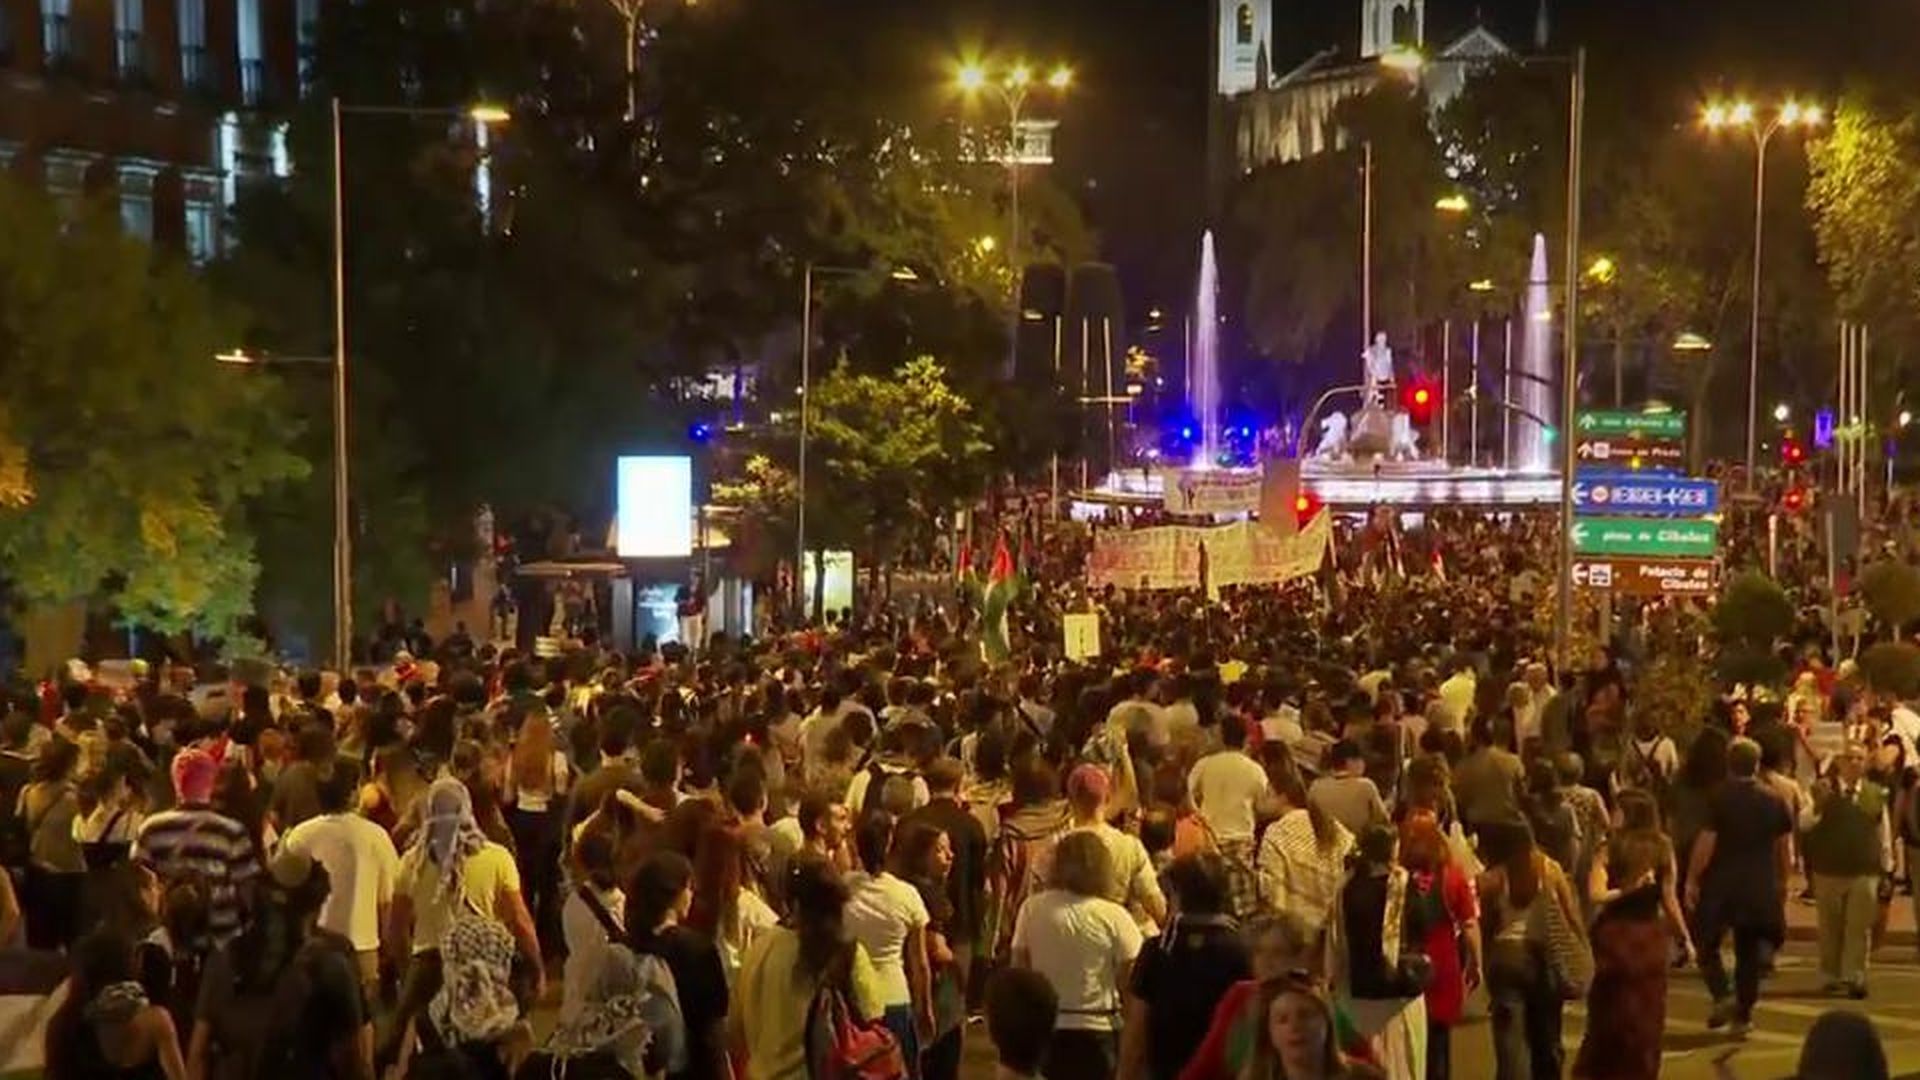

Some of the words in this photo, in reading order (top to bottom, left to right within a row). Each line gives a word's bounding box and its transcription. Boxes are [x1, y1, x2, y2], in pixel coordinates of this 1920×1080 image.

[1657, 531, 1709, 543] Cibeles
[1639, 565, 1686, 578] Palacio
[1661, 579, 1708, 589] Cibeles
